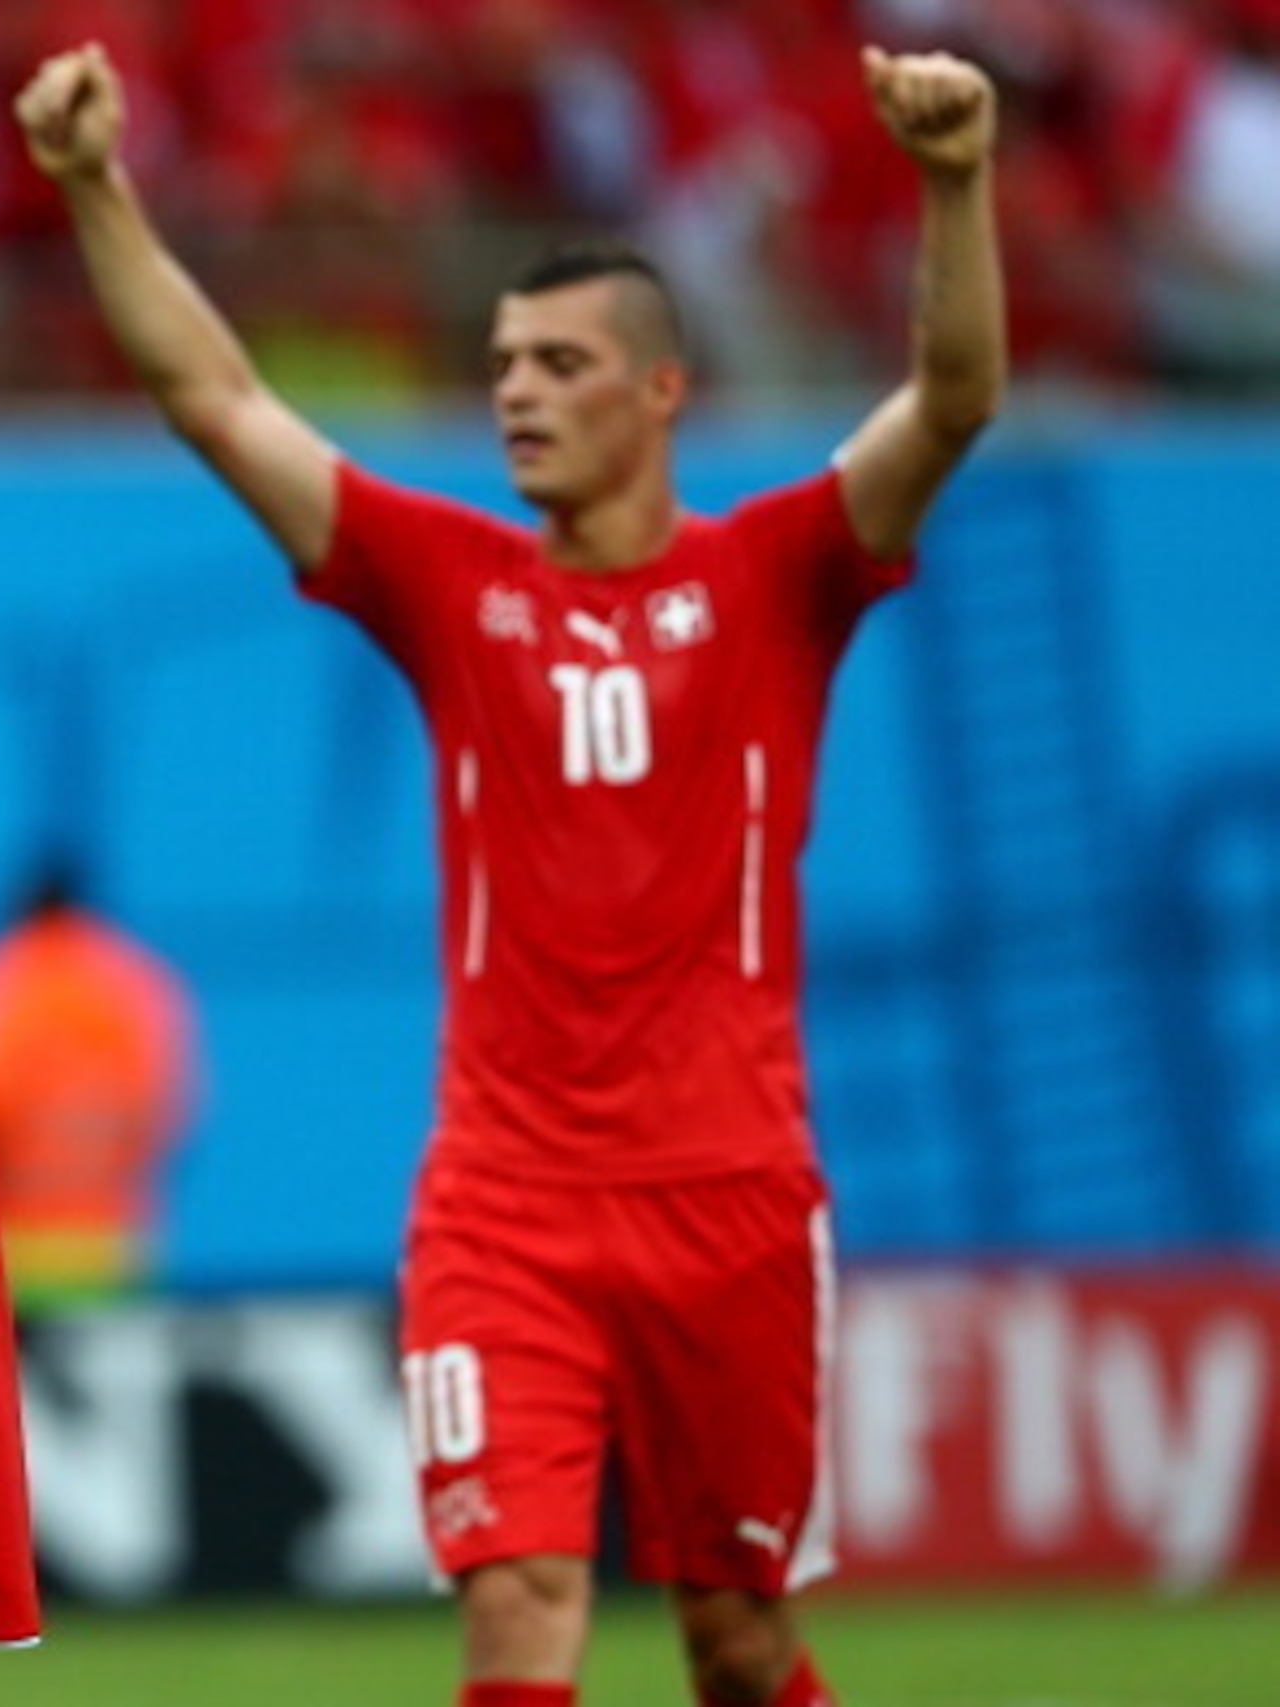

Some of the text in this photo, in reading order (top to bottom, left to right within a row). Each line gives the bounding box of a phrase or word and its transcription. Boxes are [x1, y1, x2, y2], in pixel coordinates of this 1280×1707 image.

[549, 662, 652, 786] 10
[401, 1342, 486, 1469] 10
[839, 1276, 1268, 1596] Fly
